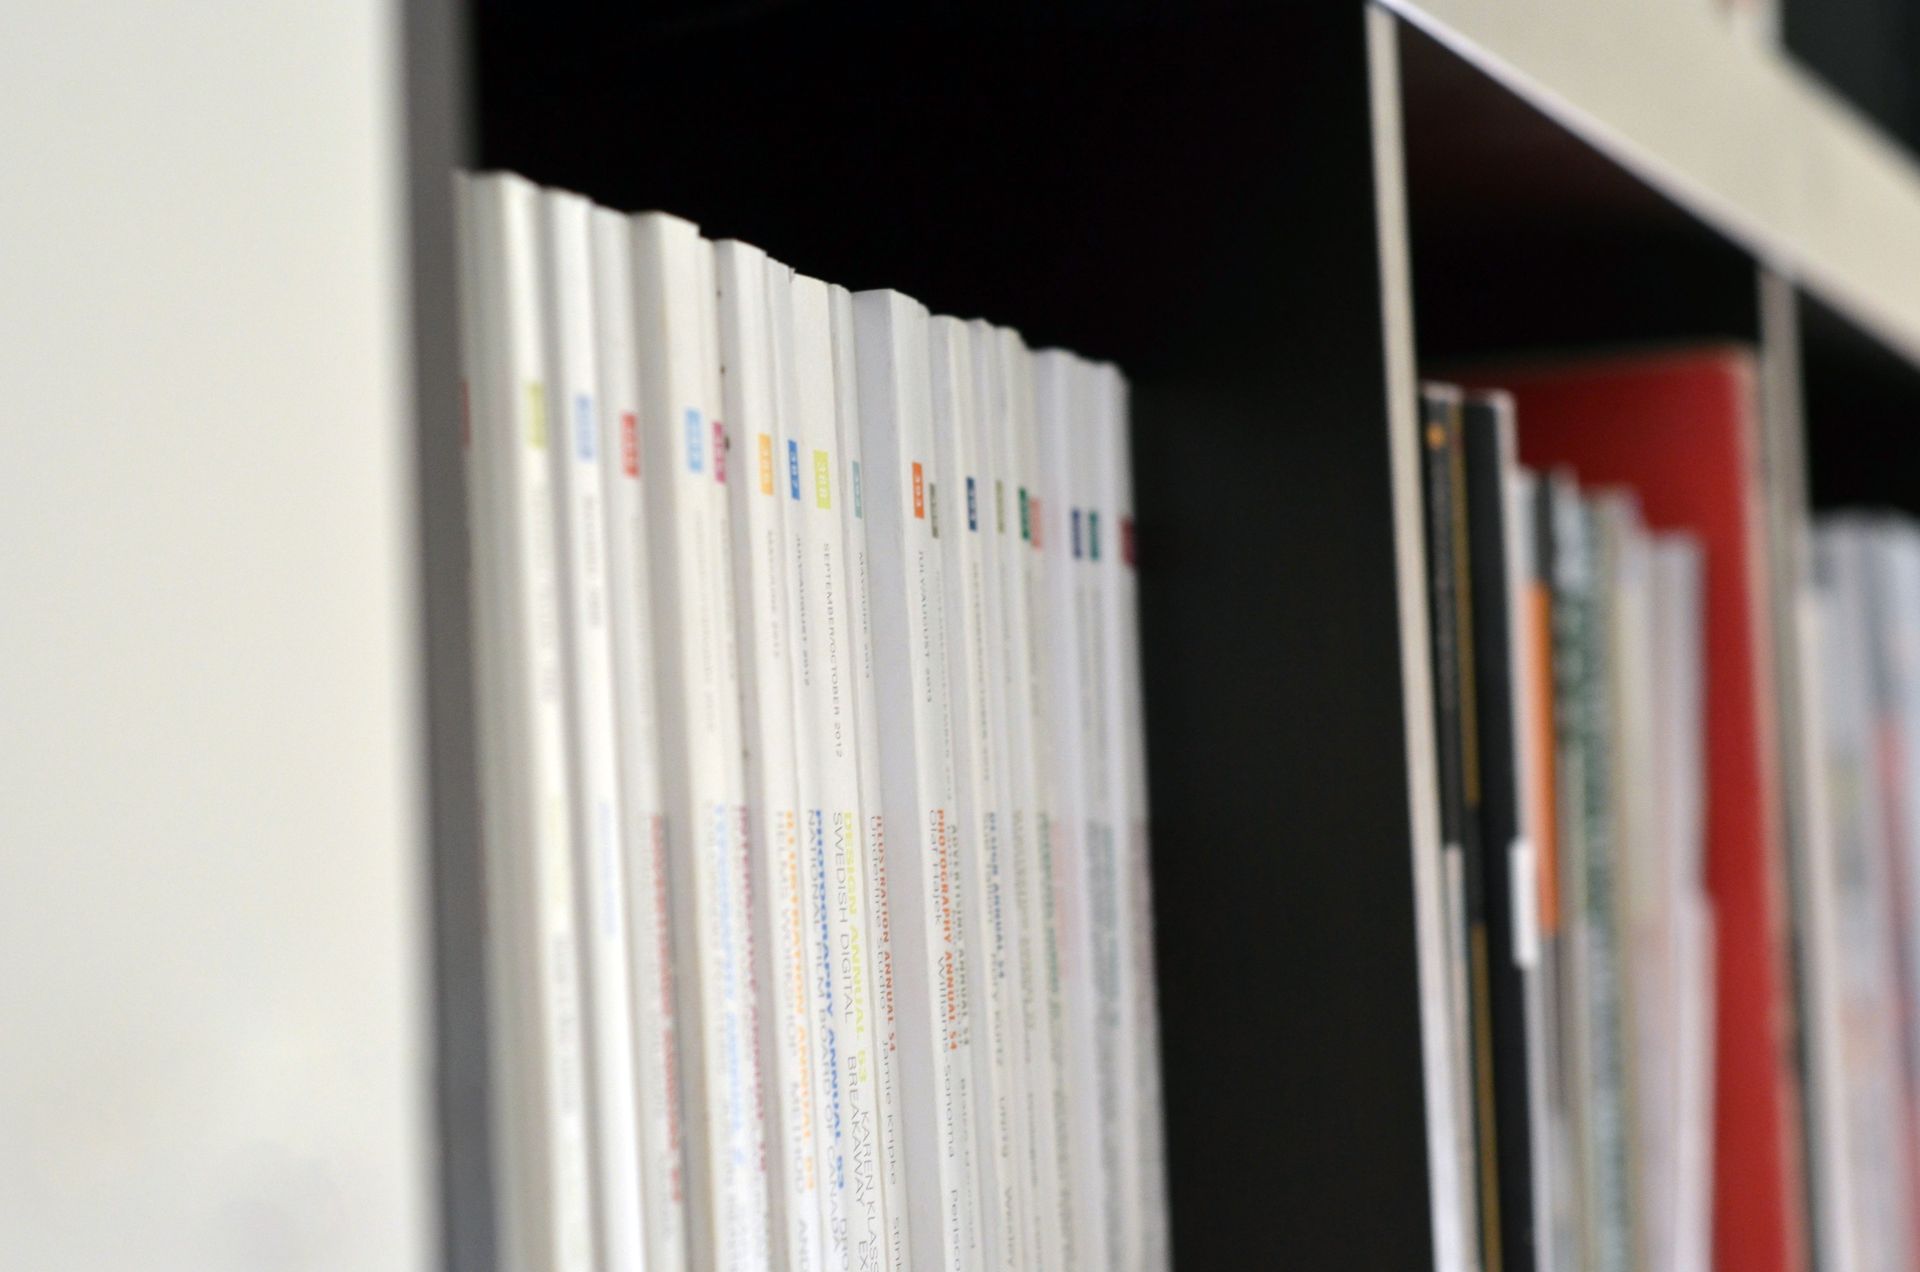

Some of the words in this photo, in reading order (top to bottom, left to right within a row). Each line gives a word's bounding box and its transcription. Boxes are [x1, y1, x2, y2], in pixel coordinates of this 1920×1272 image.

[818, 463, 828, 498] 388
[918, 550, 929, 657] JULY/AUGUST
[823, 543, 839, 715] SEPTEMBER/OCTOBER
[833, 722, 842, 758] 2012
[808, 808, 821, 925] NATIONAL
[844, 811, 857, 916] DESIGN
[929, 808, 937, 851] Olaf
[988, 812, 998, 875] DESIGN
[871, 815, 882, 928] Underline
[876, 815, 889, 943] ILLUSTRATION
[932, 863, 941, 926] Hajek
[937, 808, 952, 943] PHOTOGRAPHY
[950, 825, 962, 942] ADVERTISING
[957, 949, 968, 1016] ANNUAL
[992, 883, 1003, 950] ANNUAL
[785, 808, 804, 1014] ILLUSTRATION
[797, 1024, 812, 1138] ANNUAL
[814, 808, 833, 1016] PHOTOGRAPHY
[828, 1028, 841, 1139] ANNUAL
[836, 1154, 844, 1188] 53
[816, 941, 825, 998] FILM
[850, 924, 864, 1037] ANNUAL
[877, 936, 886, 1009] Studio
[884, 951, 894, 1024] ANNUAL
[945, 951, 956, 1020] ANNUAL
[833, 811, 848, 922] SWEDISH
[841, 933, 854, 1023] DIGITAL
[848, 1056, 865, 1206] BREAKAWAY
[888, 1031, 896, 1051] 54
[948, 1030, 957, 1050] 54
[819, 1008, 830, 1095] BOARD
[857, 1049, 867, 1083] 53
[882, 1040, 892, 1104] Jamie
[825, 1104, 833, 1130] OF
[861, 1111, 874, 1190] KAREN
[886, 1114, 896, 1185] Kripke
[827, 1145, 841, 1251] CANADA
